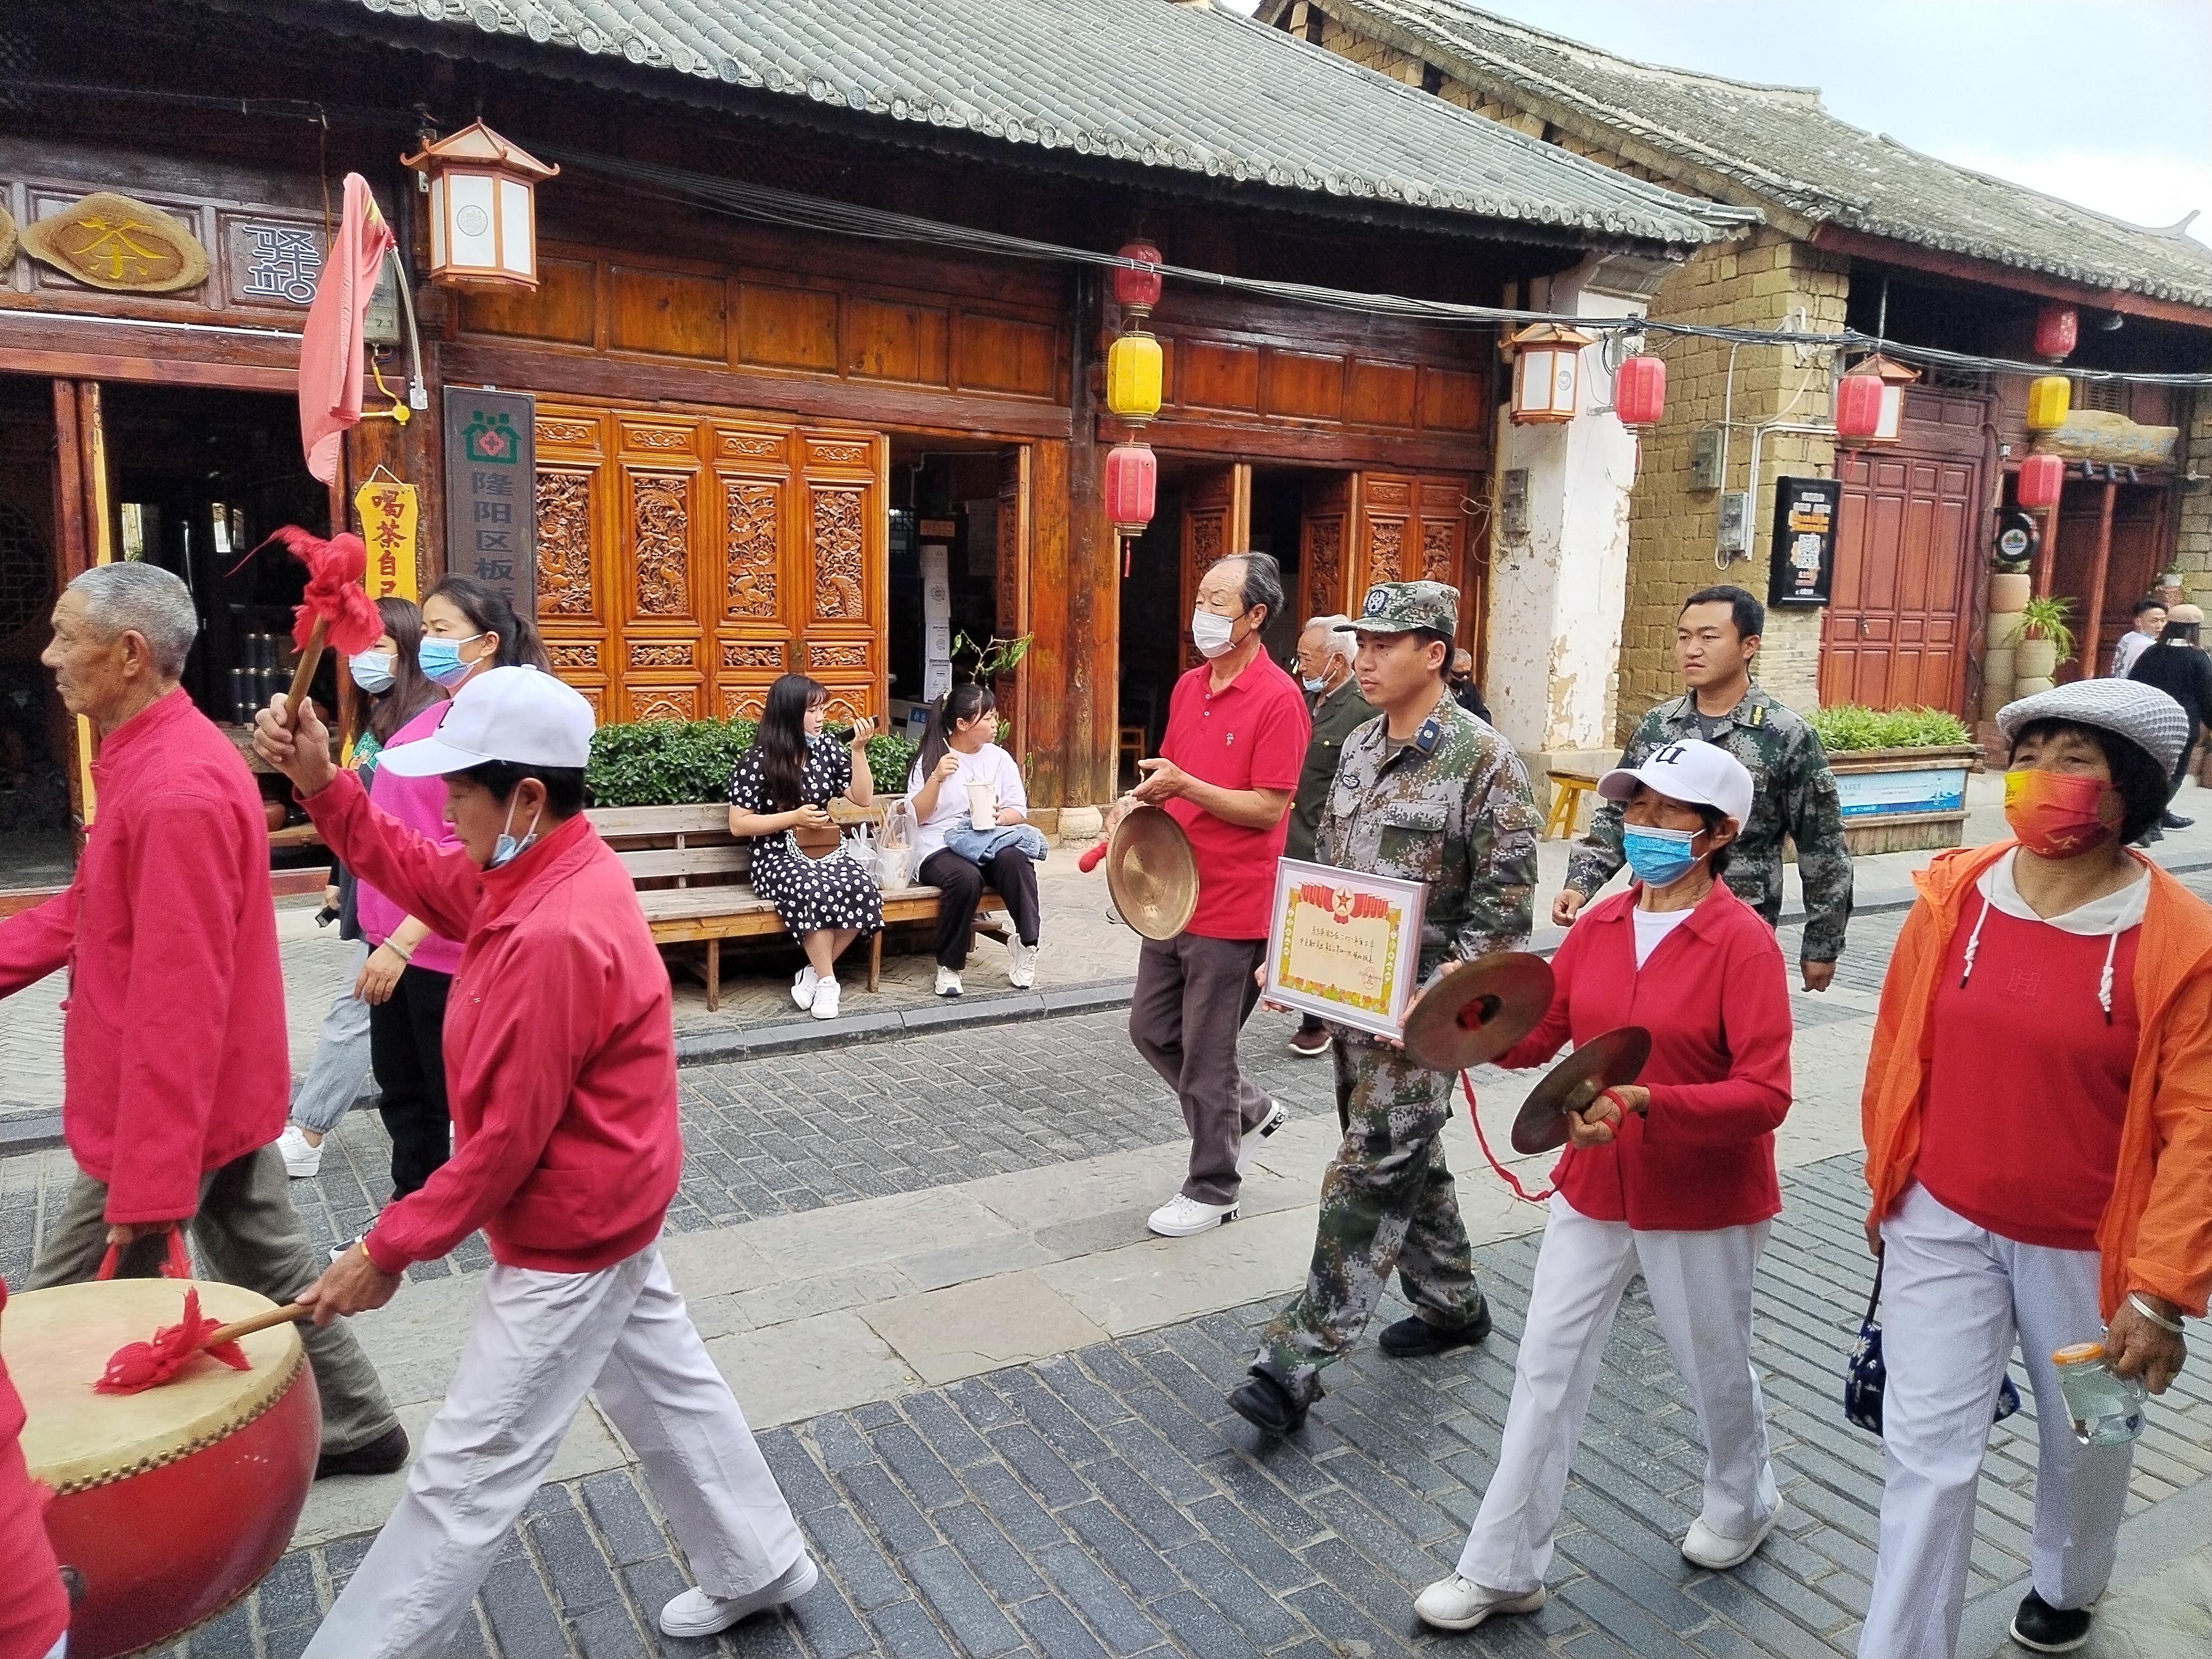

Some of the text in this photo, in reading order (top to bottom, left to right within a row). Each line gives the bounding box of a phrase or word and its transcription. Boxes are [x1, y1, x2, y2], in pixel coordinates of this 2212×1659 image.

[71, 216, 170, 279] 茶
[243, 225, 321, 304] 驿站
[472, 472, 517, 601] 隆阳区板
